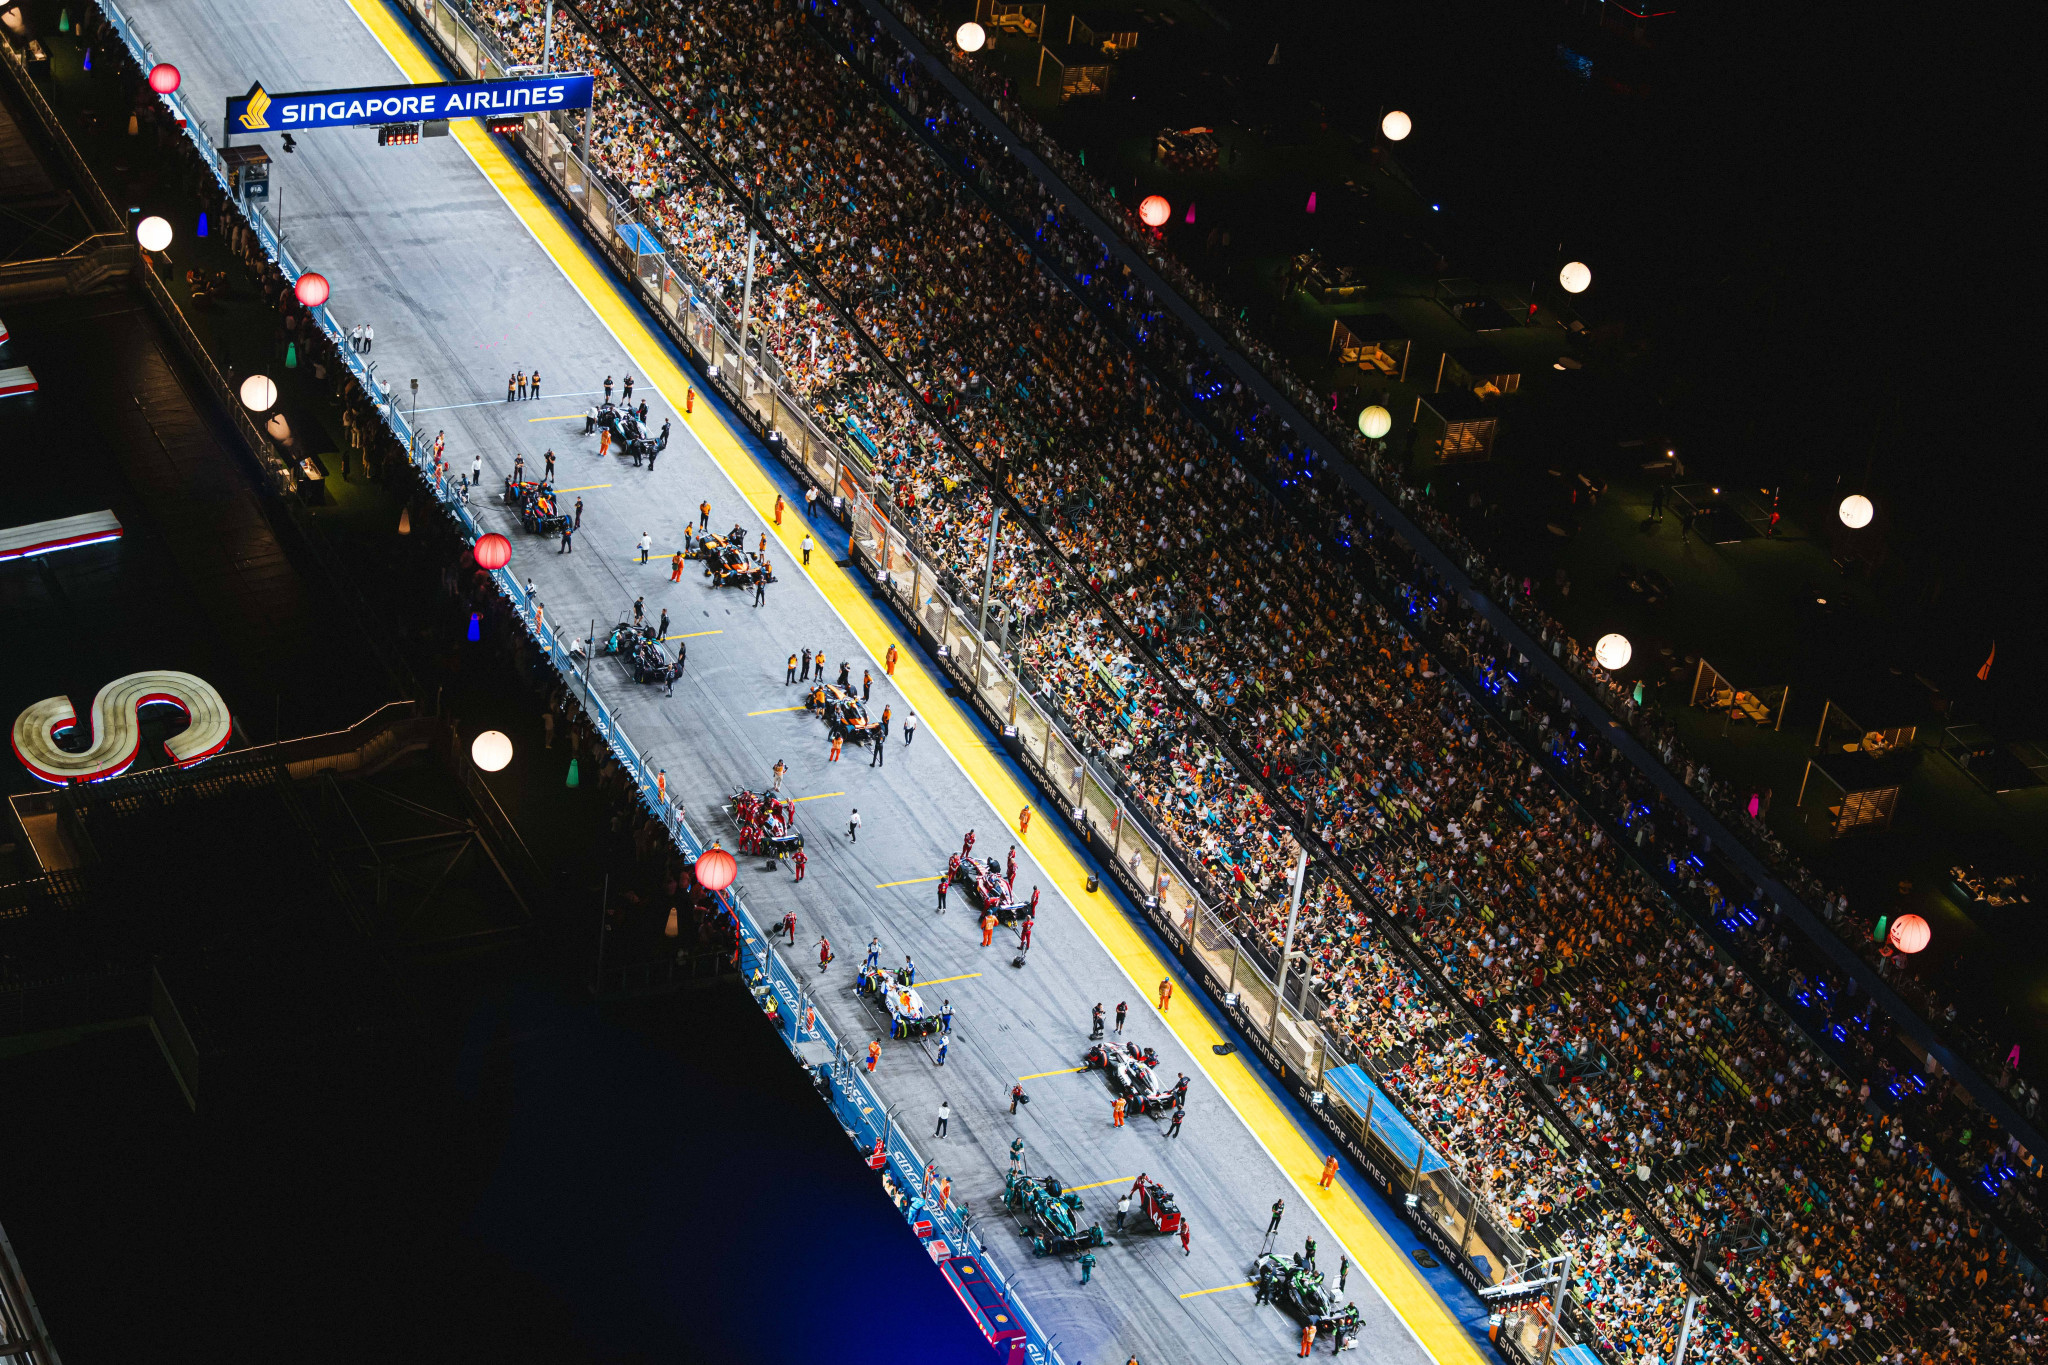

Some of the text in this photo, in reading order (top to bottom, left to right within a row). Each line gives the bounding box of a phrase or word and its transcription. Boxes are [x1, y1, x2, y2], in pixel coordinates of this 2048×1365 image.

[282, 86, 565, 123] SINGAPORE AIRLINES
[815, 489, 841, 517] IRLINES
[1021, 752, 1057, 801] SINGAPORE
[1148, 908, 1179, 949] AIRLINES
[1246, 1026, 1280, 1070] AIRLINES
[1347, 1141, 1386, 1187] AIRLINES
[1406, 1205, 1456, 1263] SINGAPORE
